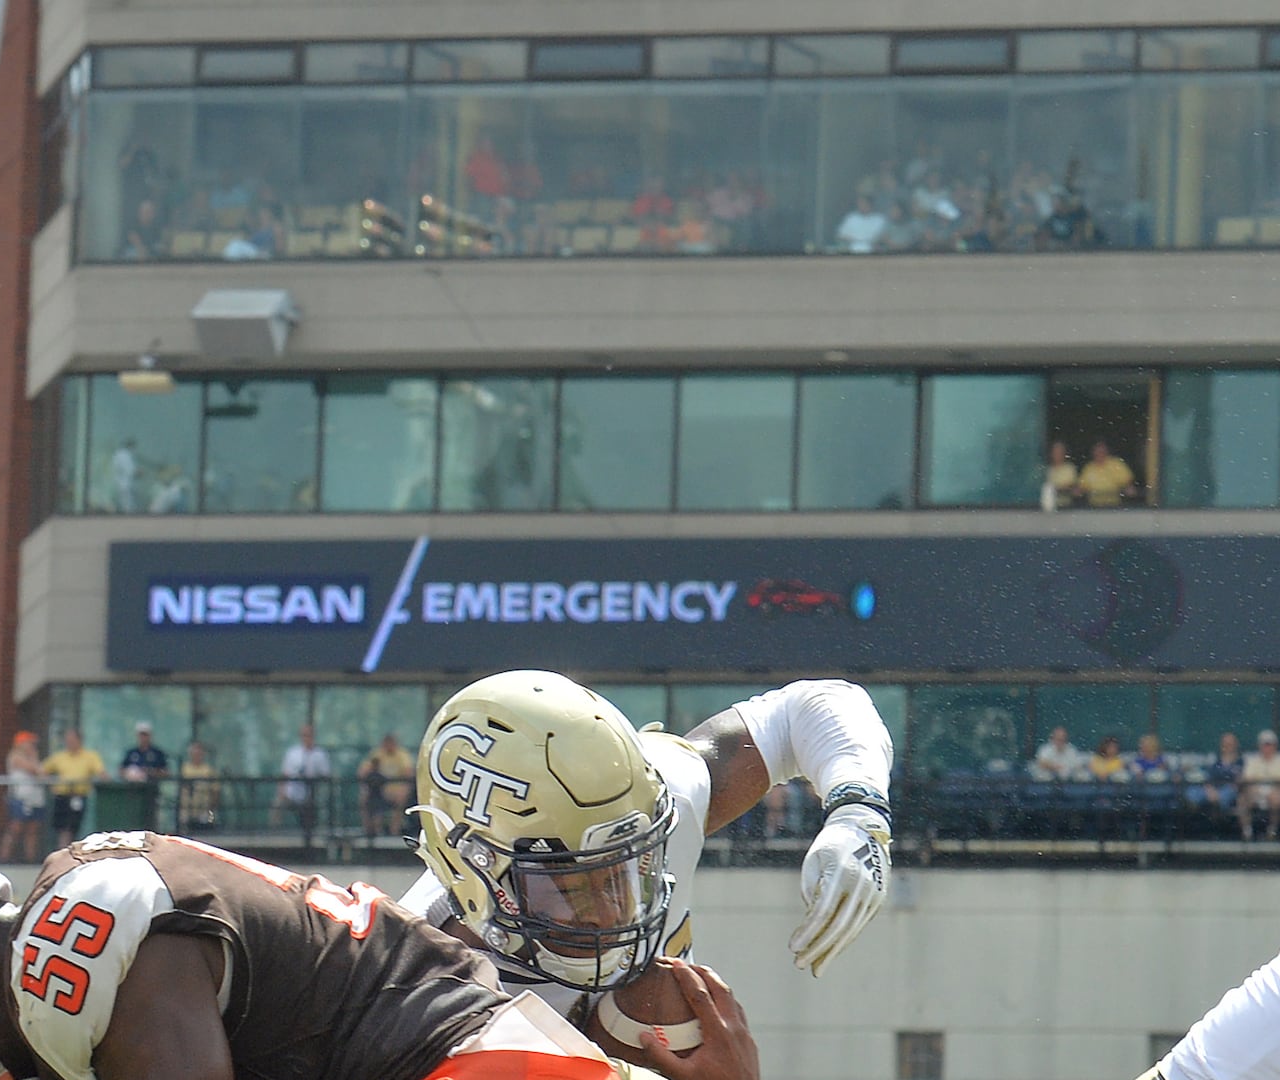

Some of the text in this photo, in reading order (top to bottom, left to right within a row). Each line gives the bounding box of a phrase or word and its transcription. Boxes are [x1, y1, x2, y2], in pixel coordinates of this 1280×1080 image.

[148, 581, 738, 624] NISSAN EMERGENCY
[428, 722, 531, 827] GT
[21, 895, 116, 1016] 55
